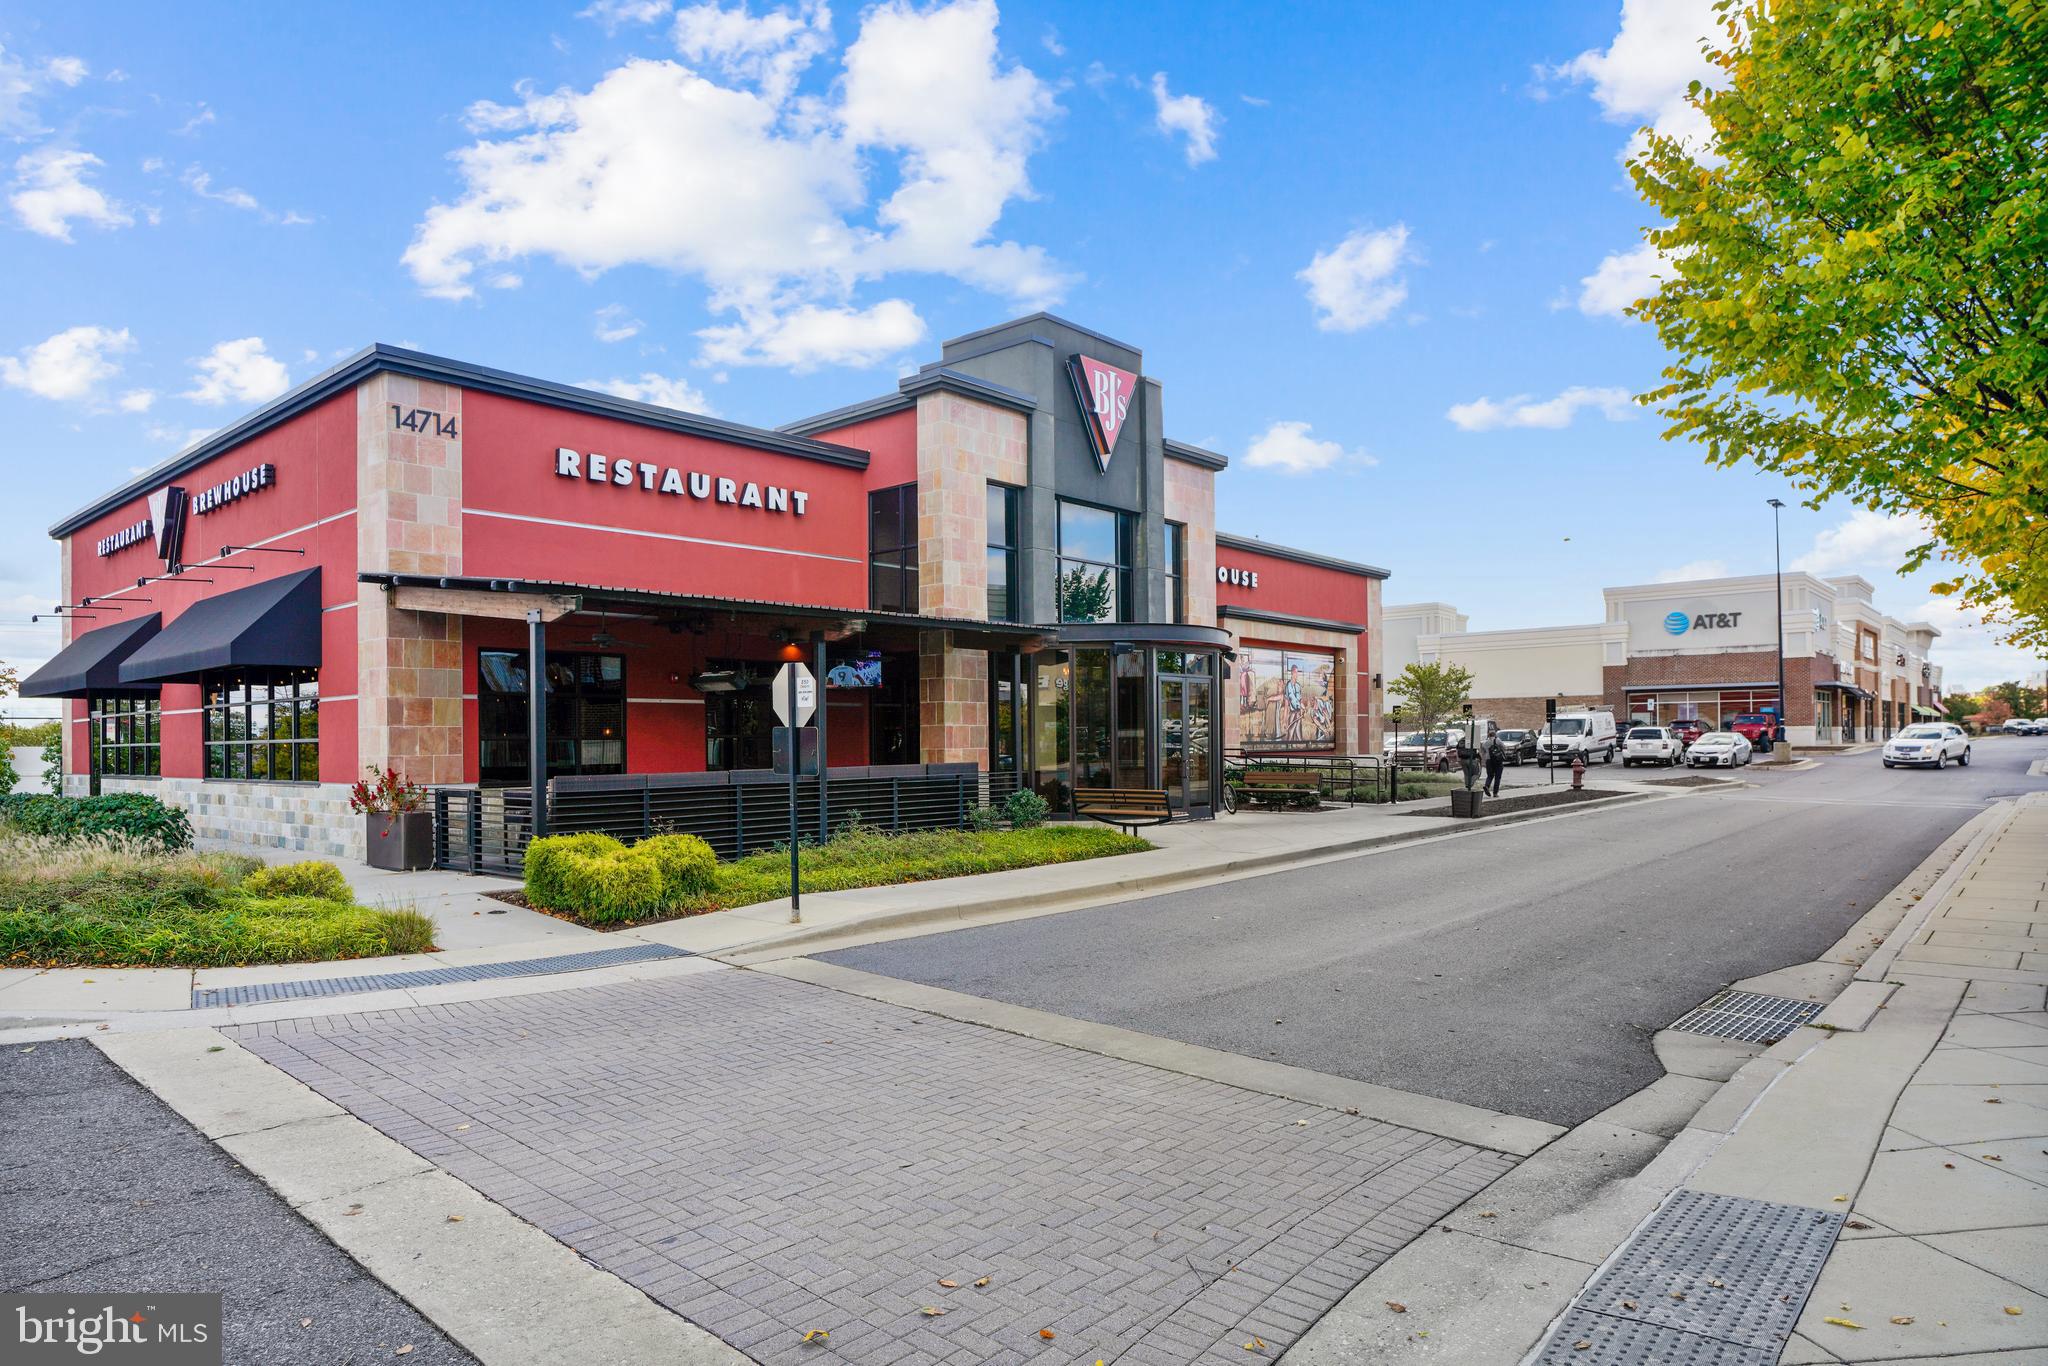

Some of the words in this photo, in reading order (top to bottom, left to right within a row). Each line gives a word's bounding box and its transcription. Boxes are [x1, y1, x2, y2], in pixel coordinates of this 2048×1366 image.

[391, 404, 458, 439] 14714
[1093, 370, 1127, 431] BJ's
[556, 446, 810, 515] RESTAURANT
[97, 520, 150, 558] RESTAURANT
[191, 463, 273, 516] BREWHOUSE
[1217, 564, 1259, 589] OUSE
[1692, 611, 1742, 631] AT&T
